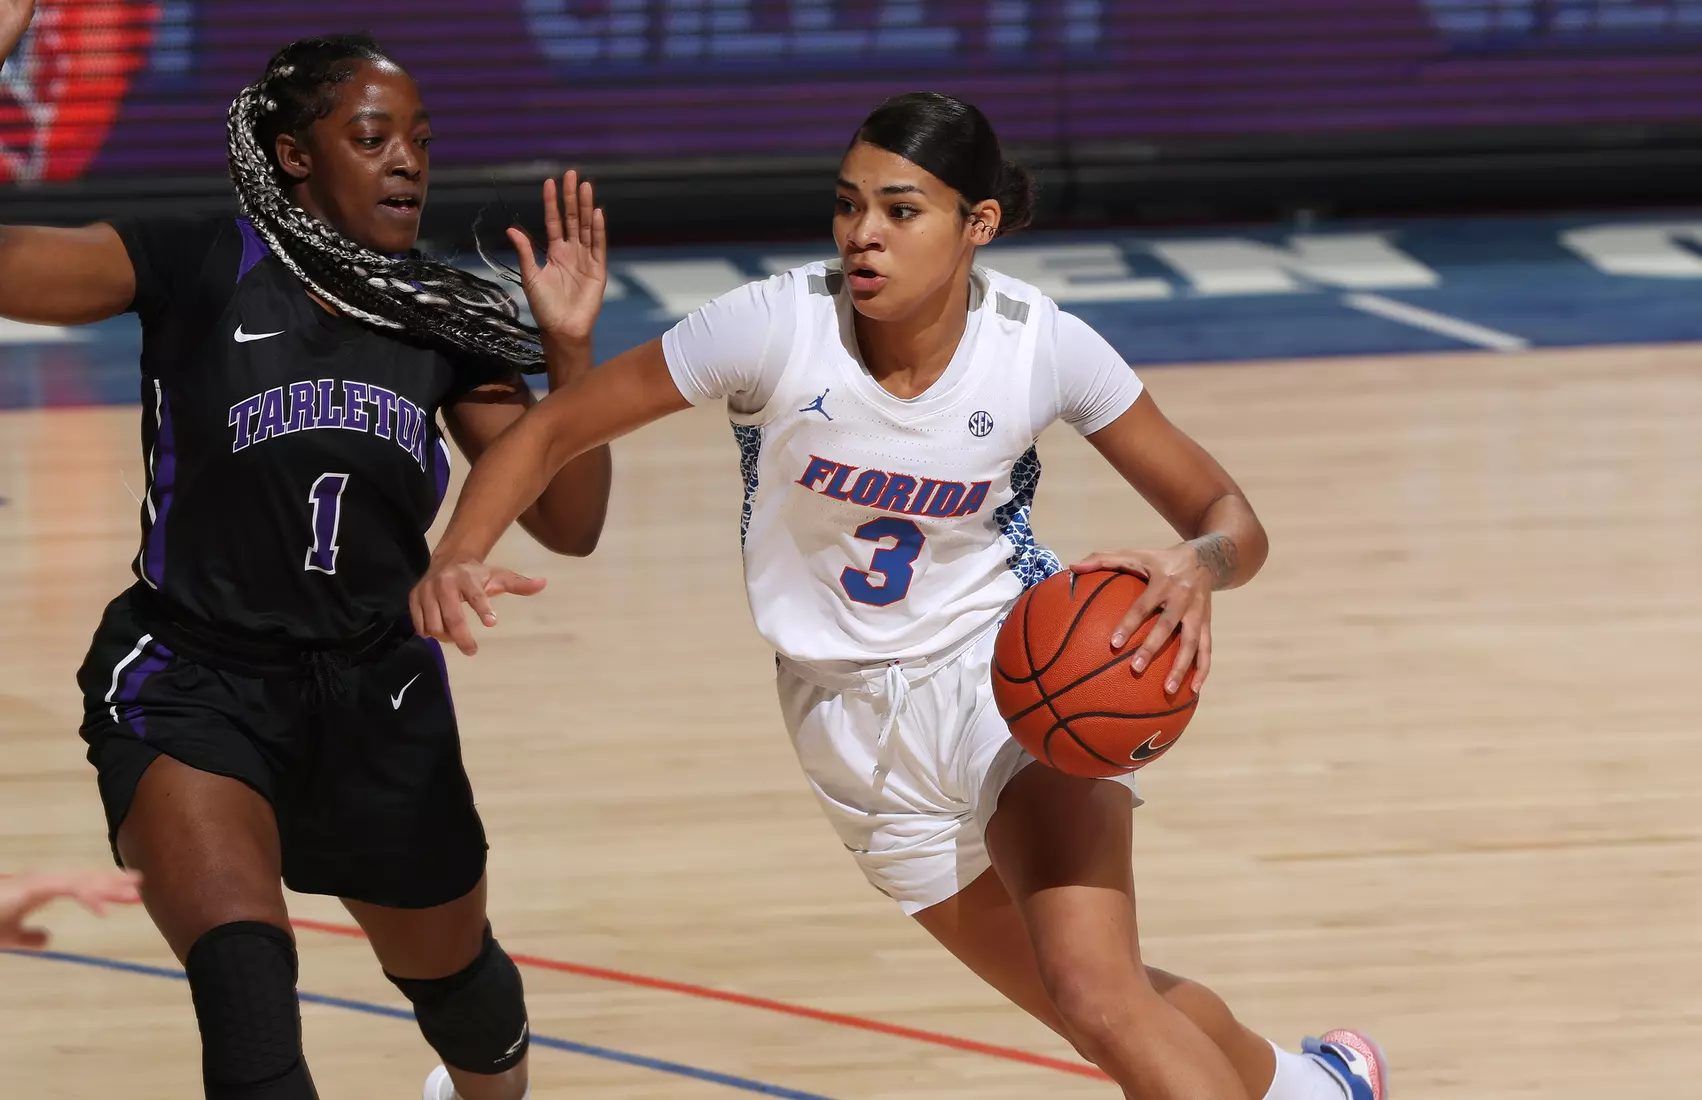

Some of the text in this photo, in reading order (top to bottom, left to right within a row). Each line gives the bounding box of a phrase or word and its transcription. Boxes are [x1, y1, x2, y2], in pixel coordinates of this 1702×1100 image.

[228, 378, 427, 473] TARLETON
[968, 410, 994, 437] SEC
[304, 472, 350, 575] 1
[794, 454, 992, 518] FLORIDA
[839, 516, 927, 607] 3
